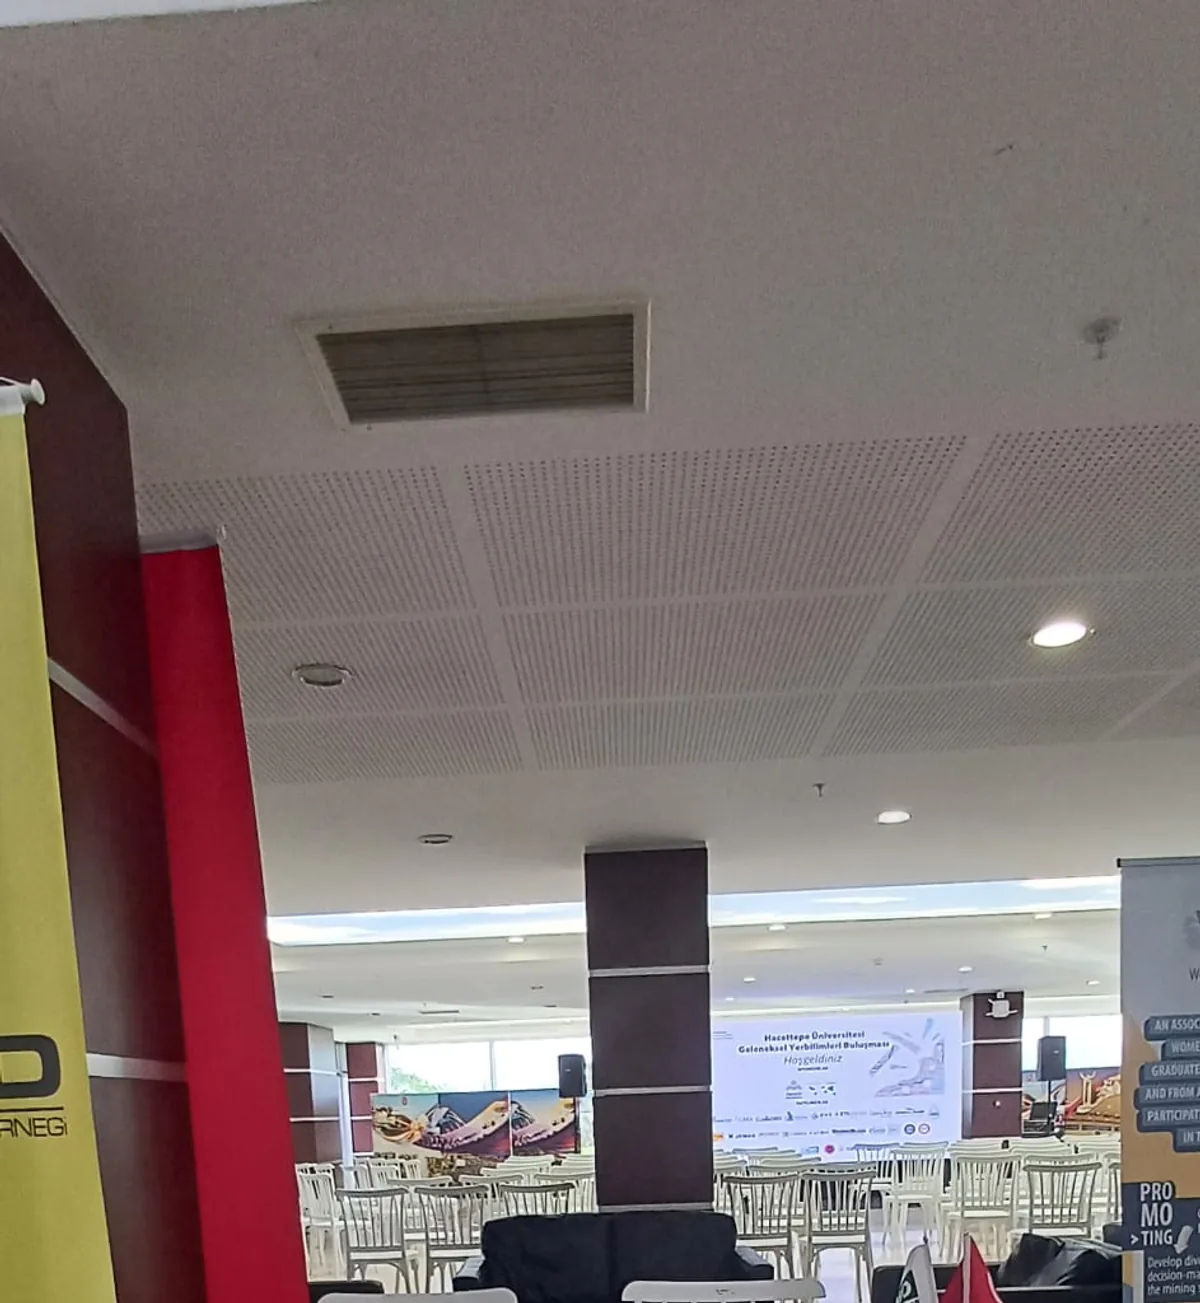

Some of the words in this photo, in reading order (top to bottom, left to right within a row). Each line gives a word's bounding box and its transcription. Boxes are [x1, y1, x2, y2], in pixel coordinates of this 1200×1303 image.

[1154, 1019, 1169, 1031] AN
[784, 1053, 843, 1066] Hoşgeldiniz
[1145, 1087, 1167, 1100] AND
[1167, 1086, 1194, 1099] FROM
[1183, 1131, 1194, 1143] IN
[1140, 1182, 1173, 1201] PRO
[1141, 1202, 1173, 1227] MO
[1147, 1255, 1182, 1270] Develop
[1147, 1283, 1161, 1296] the
[1162, 1283, 1196, 1296] mining
